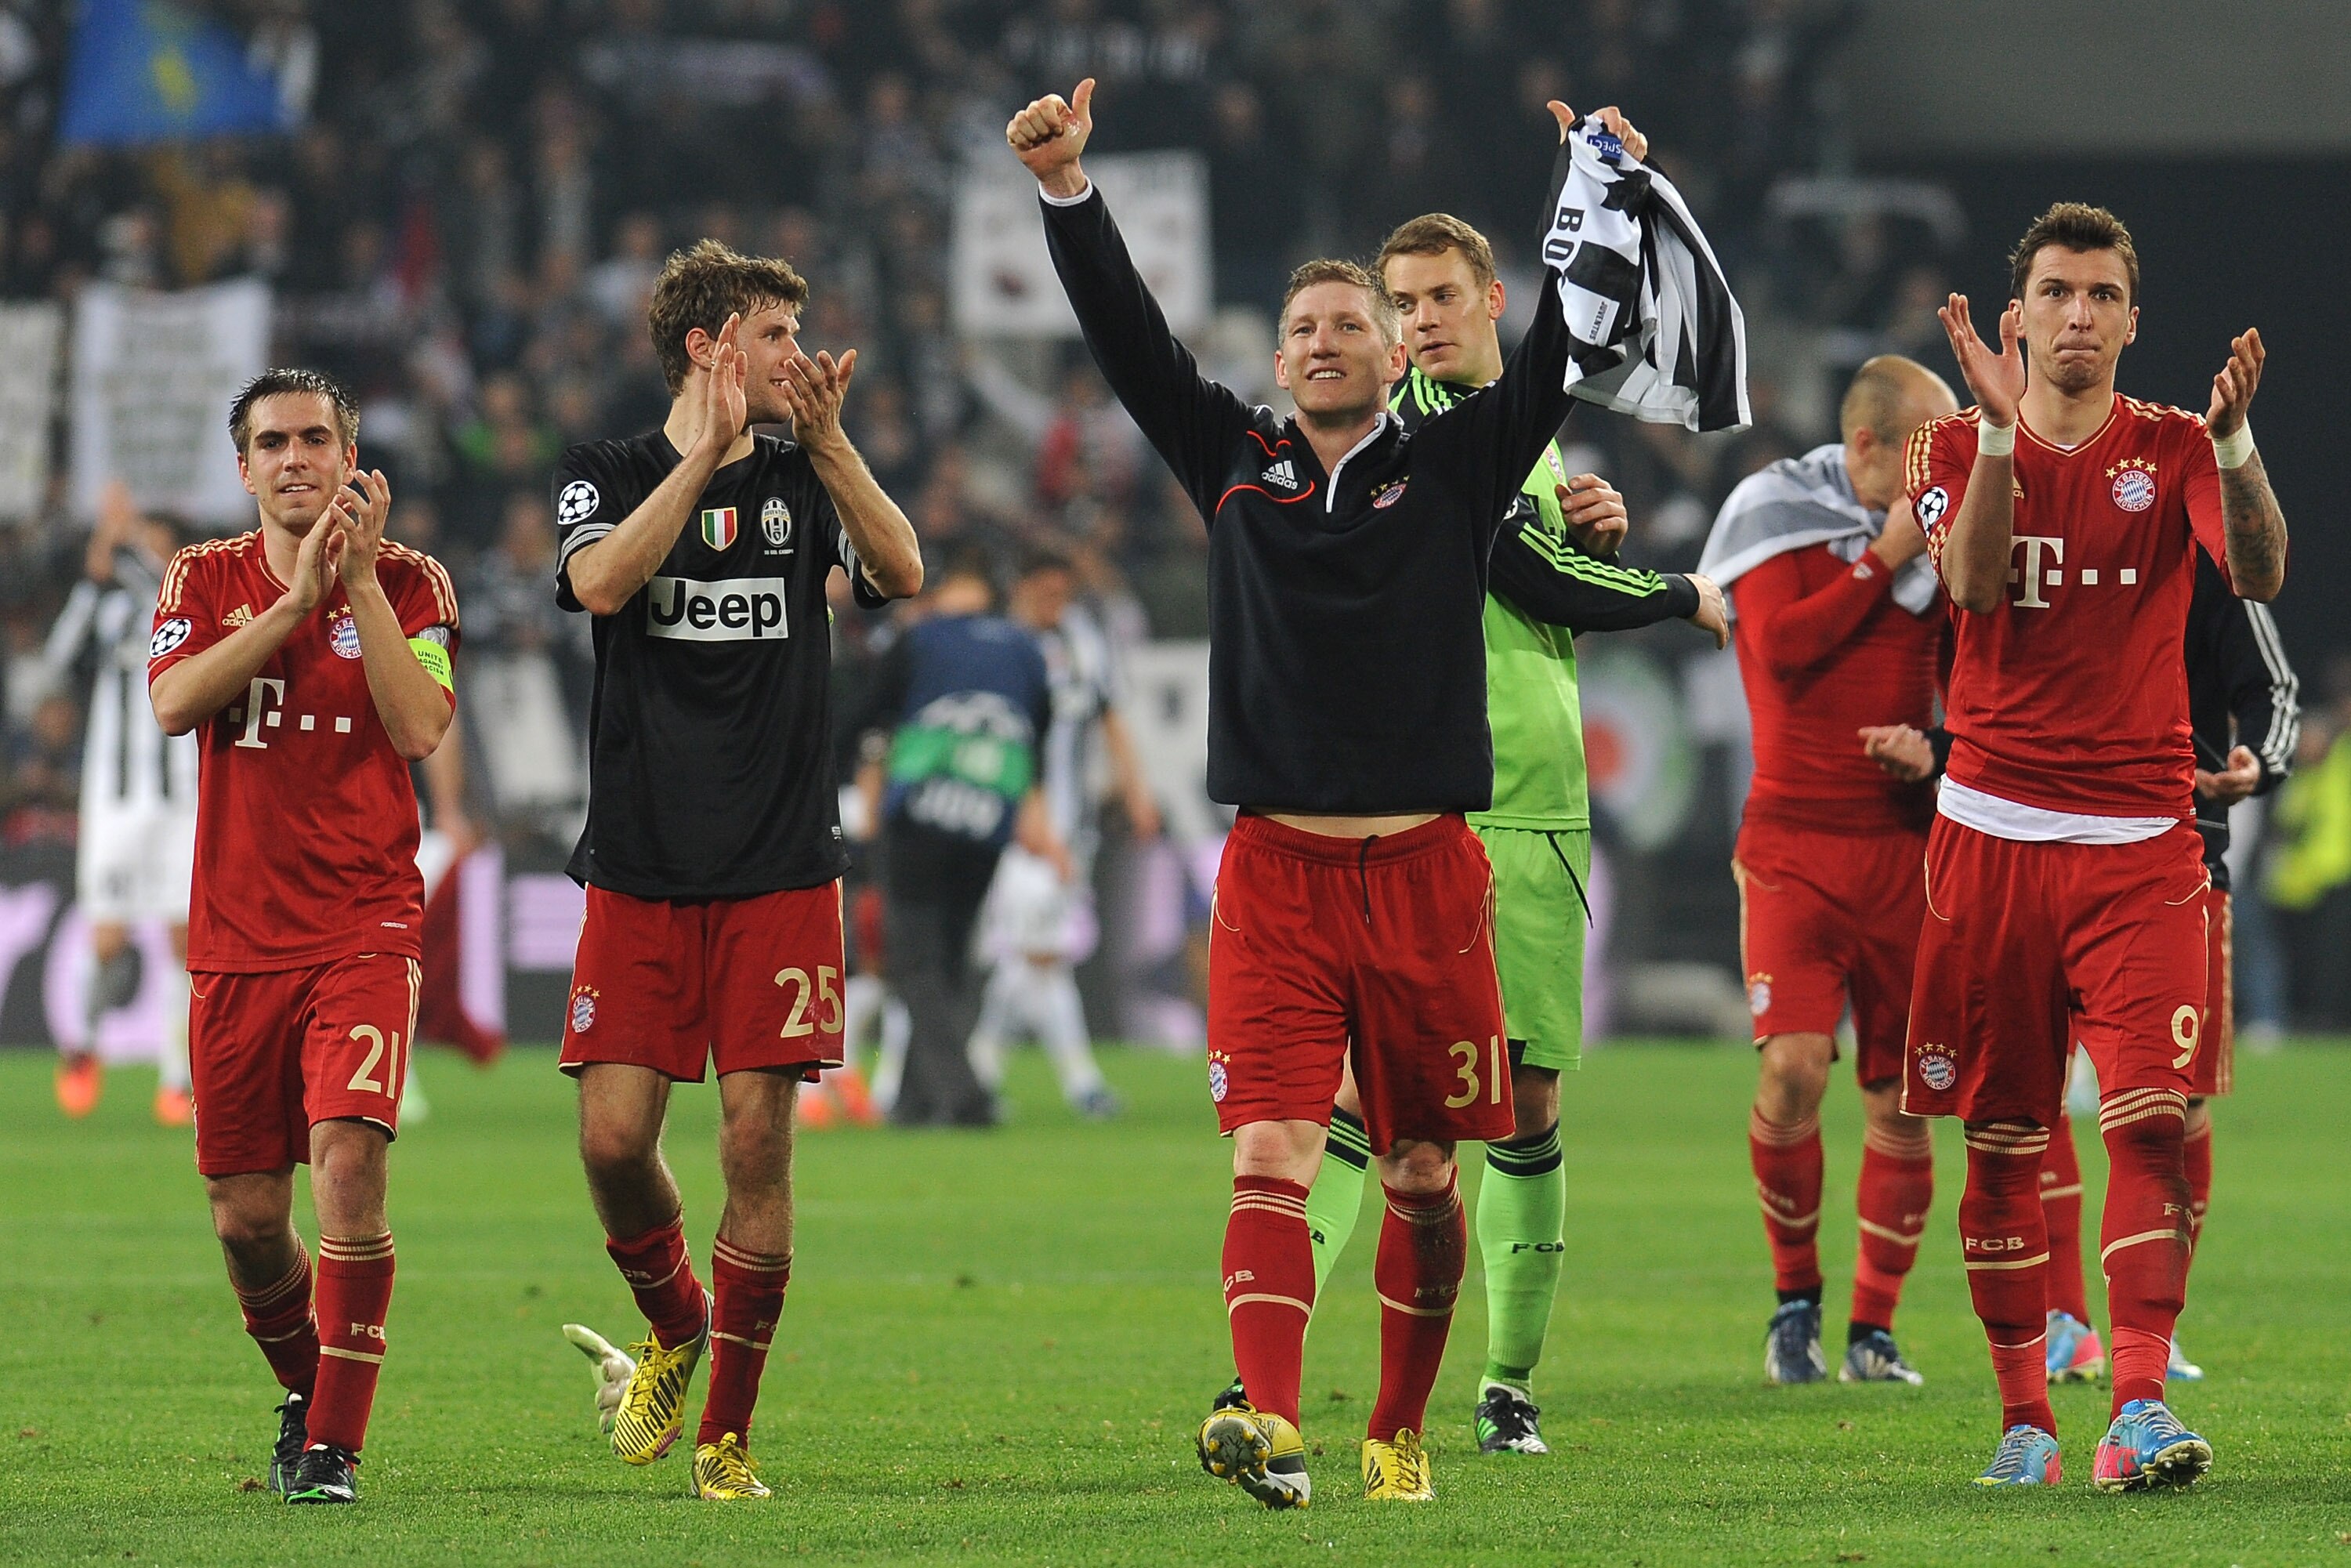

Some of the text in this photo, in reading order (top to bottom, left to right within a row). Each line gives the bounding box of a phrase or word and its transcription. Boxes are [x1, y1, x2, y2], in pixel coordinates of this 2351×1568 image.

[1588, 301, 1608, 341] JUVENTUS
[1261, 471, 1299, 491] adidas
[2122, 472, 2154, 491] BAYERN
[651, 579, 782, 638] Jeep
[222, 617, 251, 628] adid
[418, 650, 443, 664] UNITE
[418, 658, 444, 670] AGAINST
[424, 664, 444, 675] ACISM
[774, 965, 844, 1038] 25
[2170, 1004, 2199, 1070] 9
[347, 1024, 400, 1100] 21
[1444, 1034, 1501, 1109] 31
[1511, 1241, 1565, 1255] FCB
[1965, 1236, 2025, 1251] FCB
[1224, 1269, 1255, 1292] CB
